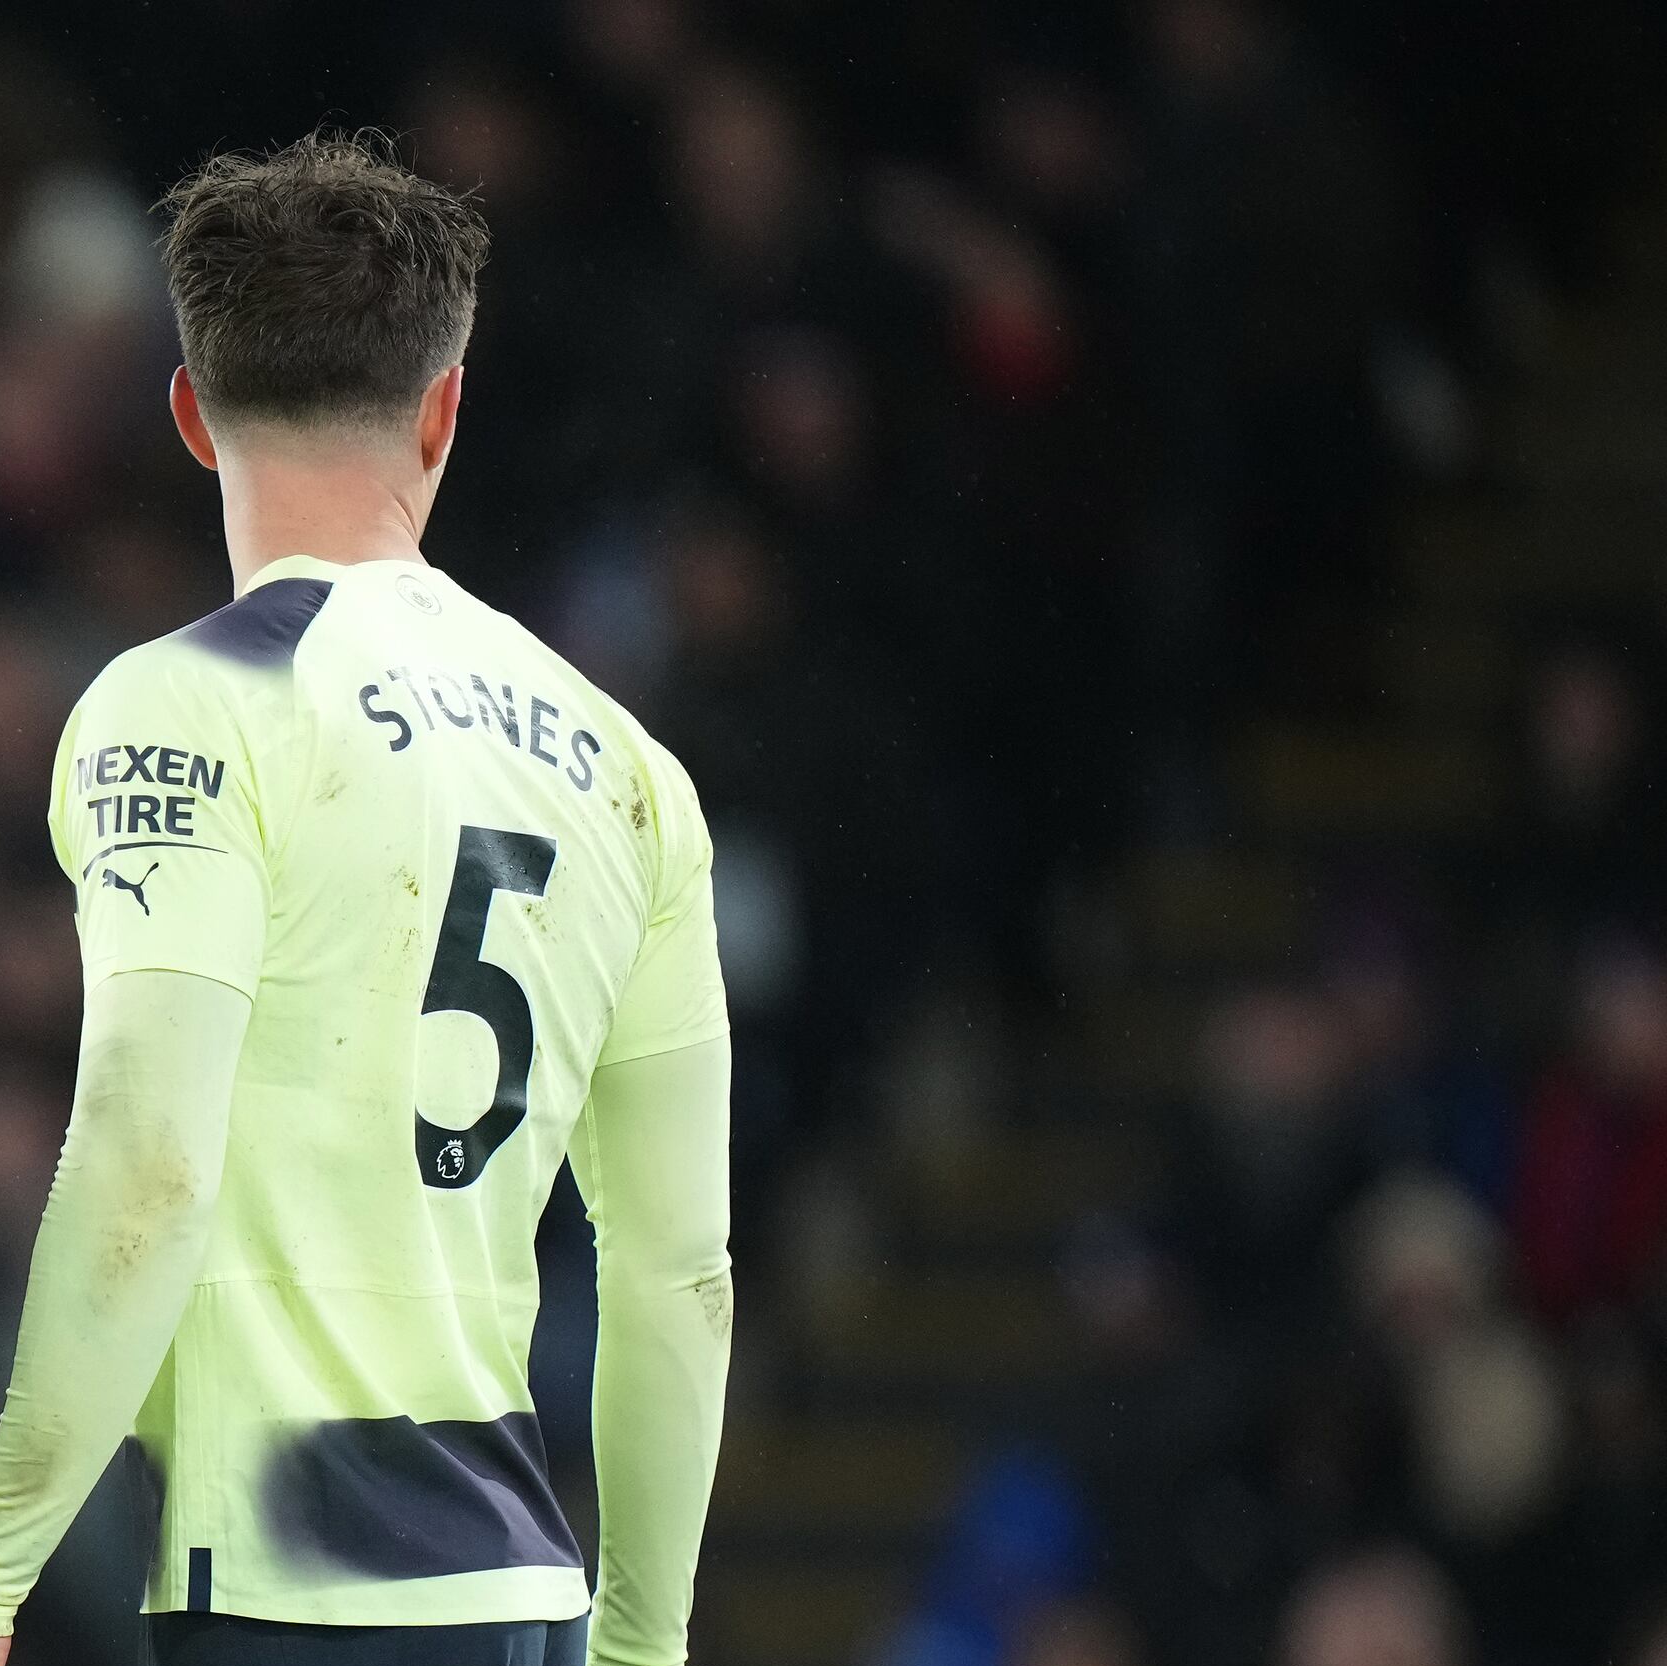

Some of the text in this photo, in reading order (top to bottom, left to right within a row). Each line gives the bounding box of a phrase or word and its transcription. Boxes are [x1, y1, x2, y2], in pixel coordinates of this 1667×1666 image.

[76, 744, 226, 799] NEXEN
[358, 665, 602, 791] STONES
[87, 794, 195, 837] TIRE
[414, 824, 557, 1191] 5
